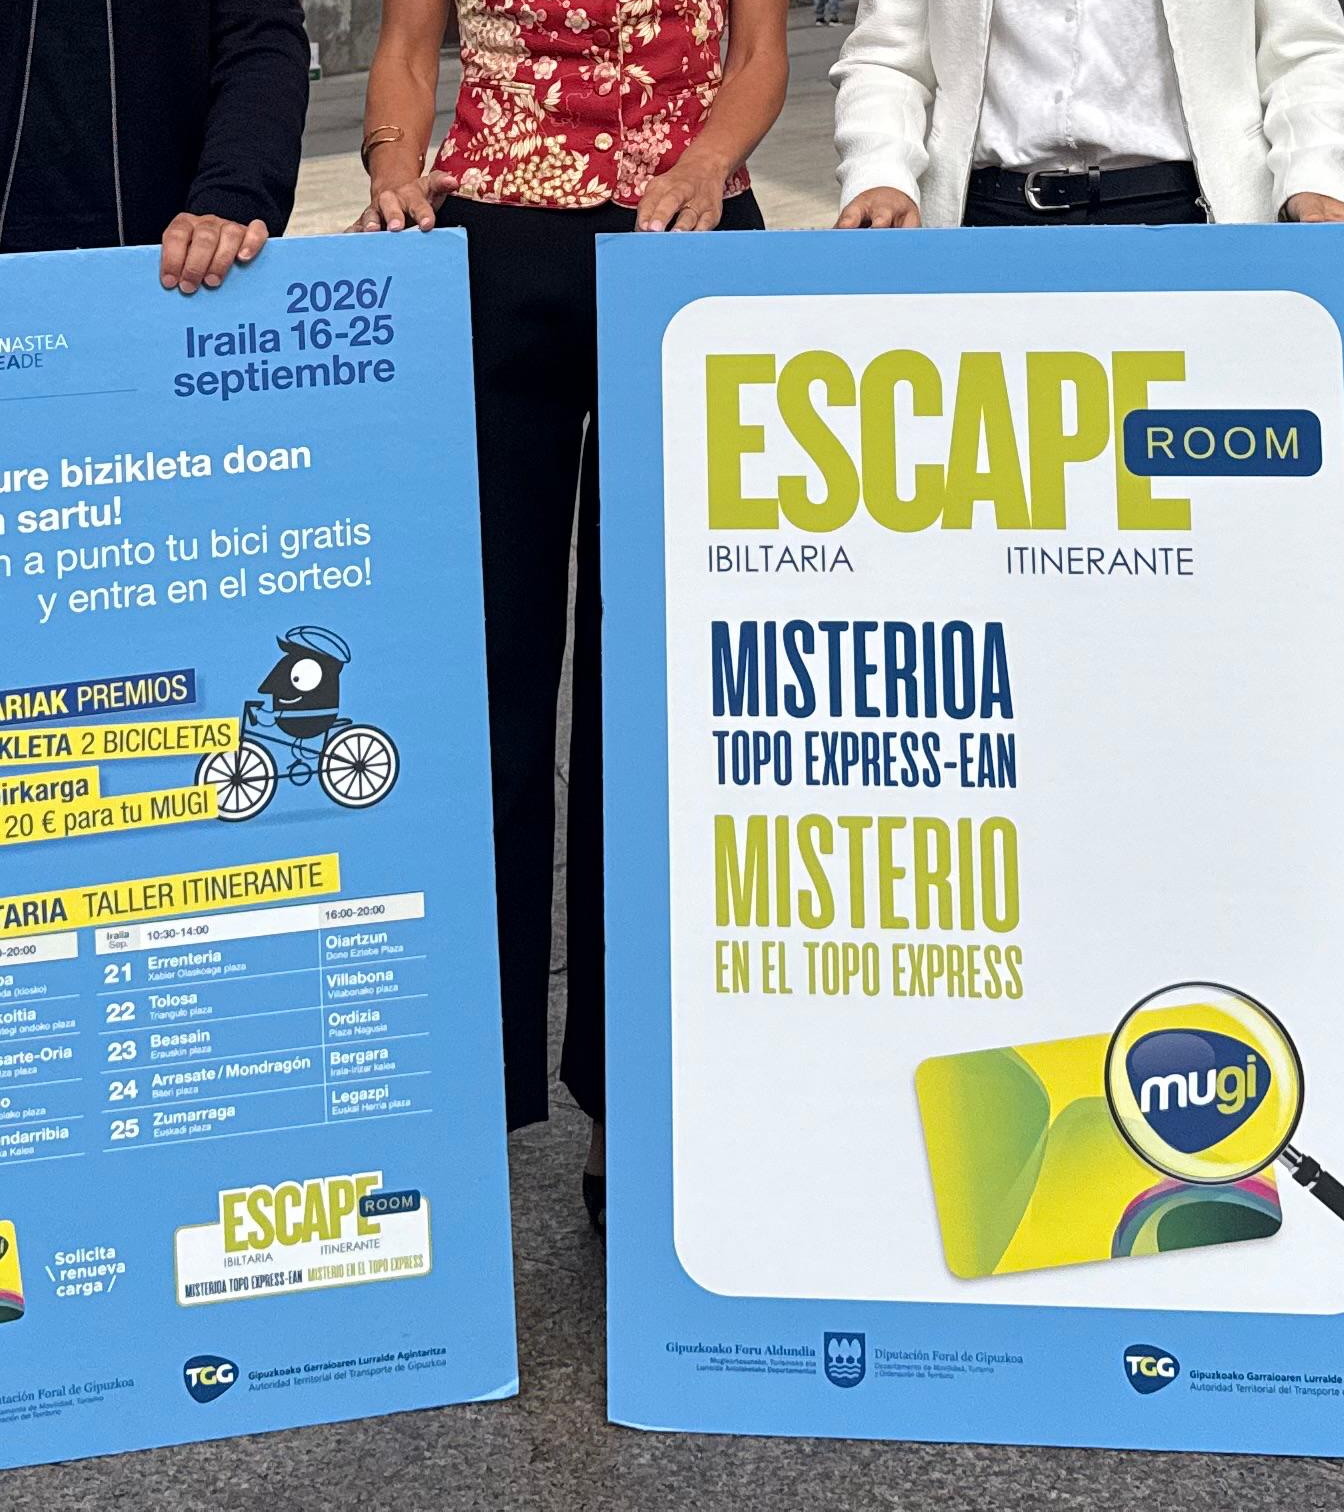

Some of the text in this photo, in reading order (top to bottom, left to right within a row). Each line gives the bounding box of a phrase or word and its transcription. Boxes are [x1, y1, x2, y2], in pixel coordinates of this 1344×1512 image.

[186, 314, 394, 359] Iraila 16-25
[174, 354, 396, 402] septiembre
[705, 349, 1299, 533] ESCAPE ROOM
[61, 450, 212, 488] bizikleta
[223, 444, 311, 474] doan
[17, 495, 122, 534] sartu!
[24, 551, 46, 575] a
[56, 538, 156, 580] punto
[165, 534, 199, 562] tu
[210, 524, 268, 558] bici
[279, 517, 372, 560] gratis
[708, 544, 1194, 576] IBILTARIA ITINERANTE
[37, 556, 372, 624] y entra en el sorteo!
[711, 619, 1014, 720] MISTERIOA
[77, 674, 188, 712] PREMIOS
[81, 732, 95, 755] 2
[104, 723, 231, 754] BICICLETAS
[712, 729, 1017, 789] TOPO EXPRESS-EAN
[4, 813, 34, 843] 20
[41, 809, 57, 834] €
[62, 807, 117, 837] para
[120, 801, 142, 829] tu
[150, 792, 210, 823] MUGI
[714, 813, 1020, 934] MISTERIO
[82, 882, 174, 918] TALLER
[183, 862, 323, 905] ITINERANTE
[325, 904, 386, 921] 16:00-20:00
[147, 924, 210, 941] 10:30-14:00
[325, 932, 388, 950] Oiartzun
[147, 949, 222, 971] Errenteria
[715, 940, 1024, 1000] EN EL TOPO EXPRESS
[104, 962, 132, 984] 21
[326, 970, 394, 988] Villabona
[106, 1001, 136, 1023] 22
[148, 993, 198, 1009] Tolosa
[328, 1008, 381, 1027] Ordizia
[150, 1029, 211, 1049] Beasain
[107, 1040, 138, 1062] 23
[330, 1048, 389, 1065] Bergara
[108, 1079, 139, 1102] 24
[331, 1084, 389, 1105] Legazpi
[1139, 1052, 1261, 1117] mugi
[153, 1106, 236, 1126] Zumarraga
[110, 1118, 140, 1141] 25
[222, 1174, 413, 1253] ESCAPE ROOM
[54, 1246, 117, 1266] Solicita
[223, 1237, 381, 1268] IBILTARIA ITINERANTE
[60, 1262, 126, 1281] renueva
[56, 1280, 104, 1297] carga
[665, 1341, 816, 1357] Gipuzkoako Foru Aldundia
[874, 1348, 1024, 1366] Diputación Foral de Gipuzkoa
[185, 1366, 235, 1387] TGG
[1126, 1355, 1175, 1378] TGG
[38, 1384, 67, 1400] Foral
[68, 1383, 82, 1396] de
[83, 1377, 135, 1395] Gipuzkoa
